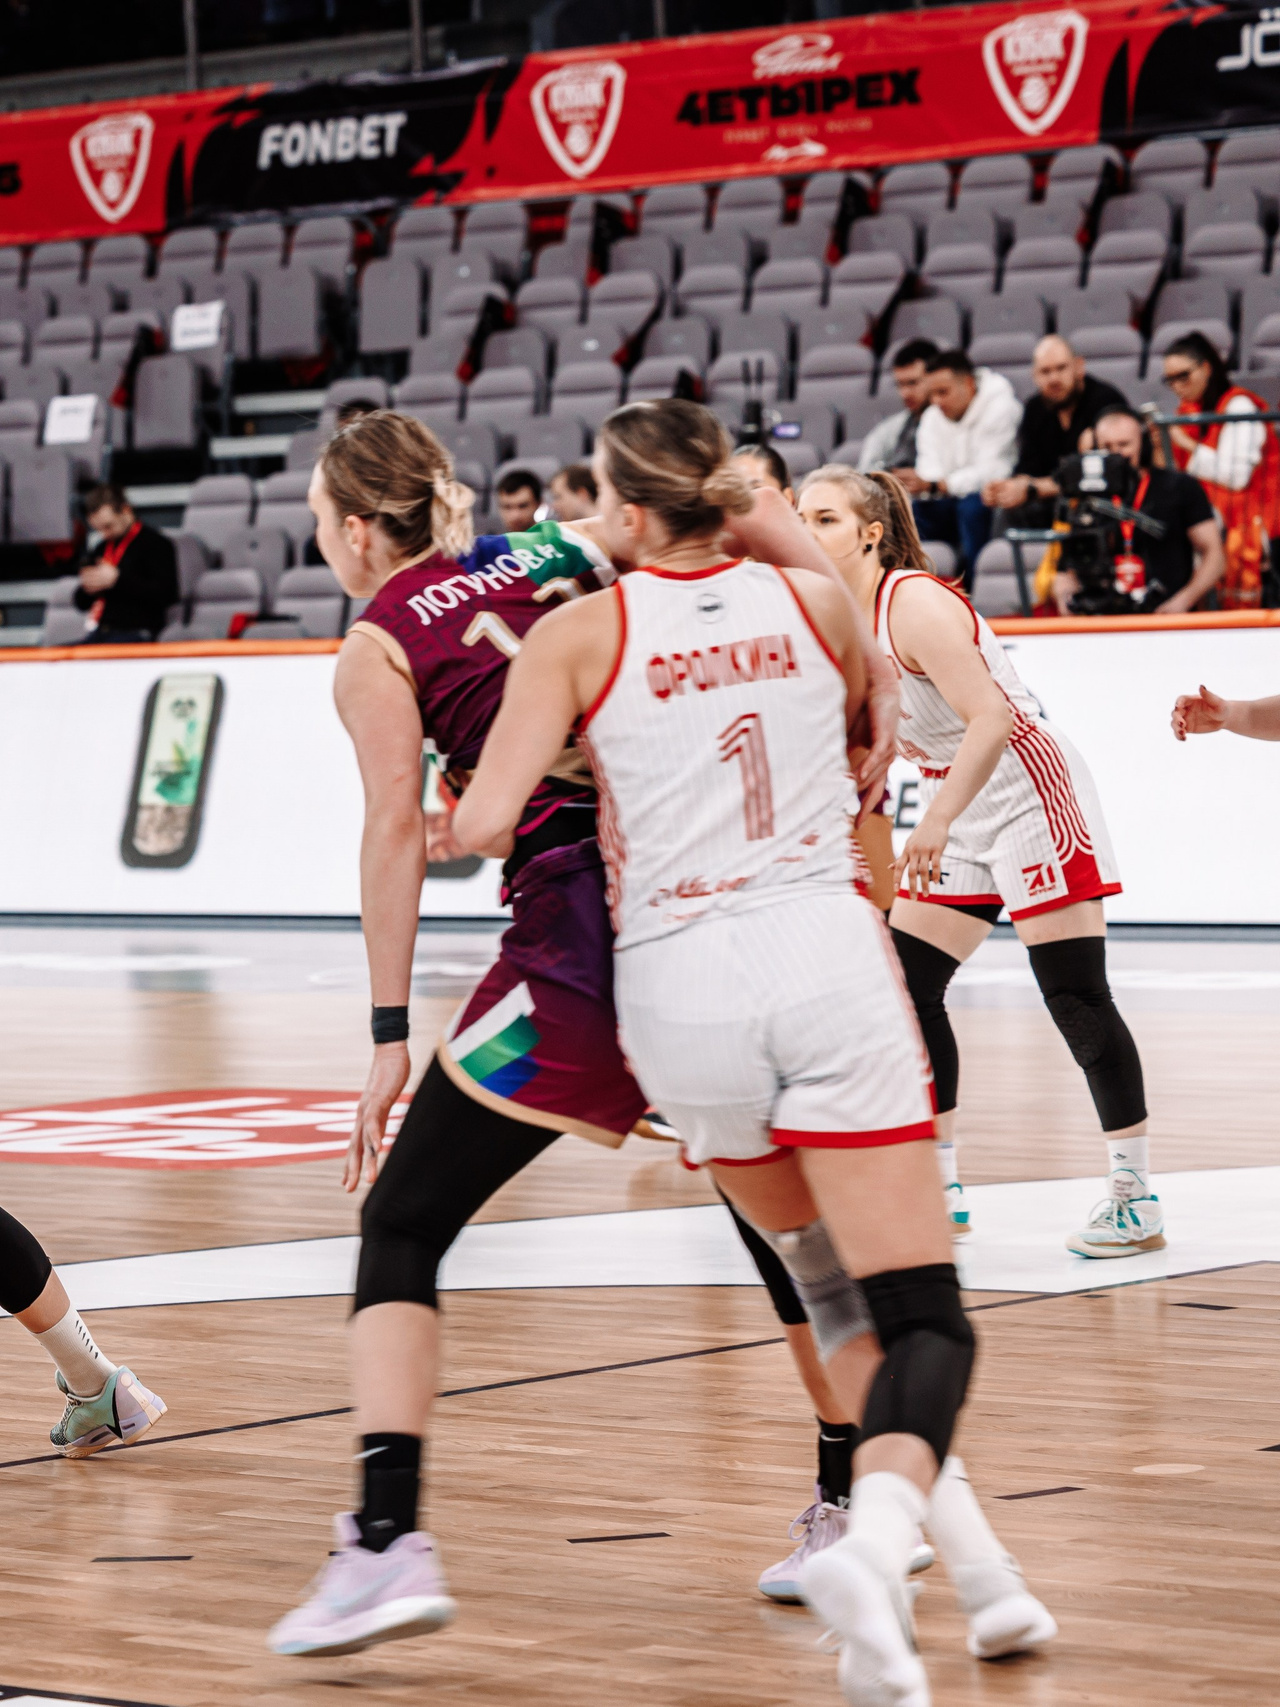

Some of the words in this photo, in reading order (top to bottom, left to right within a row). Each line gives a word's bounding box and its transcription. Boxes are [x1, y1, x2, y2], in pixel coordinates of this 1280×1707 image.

[257, 111, 407, 170] FONBET
[406, 542, 565, 626] ЛОГУНОВА
[716, 712, 775, 842] 1
